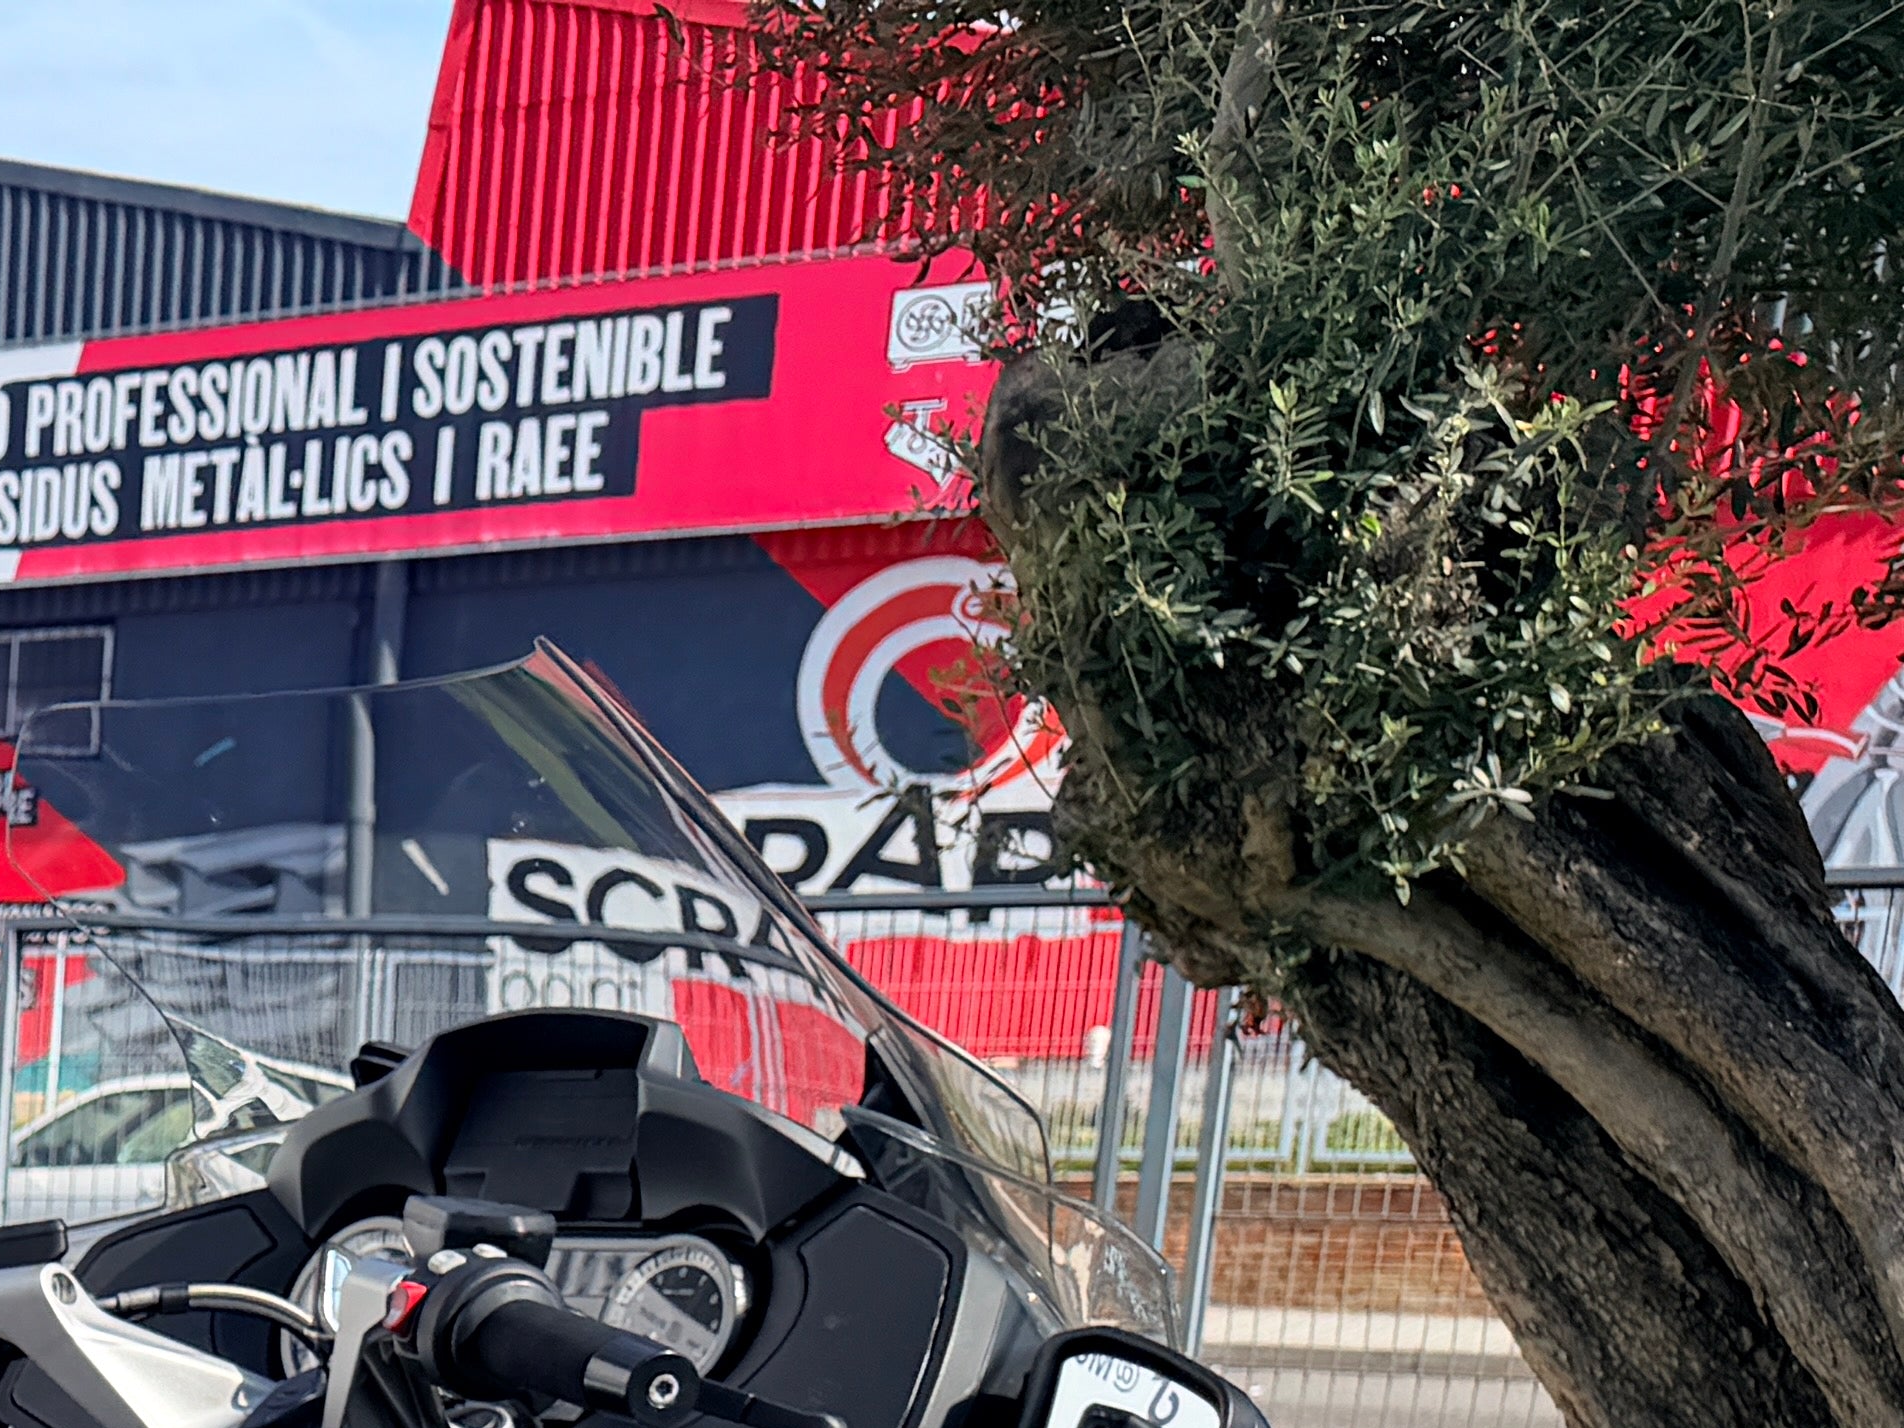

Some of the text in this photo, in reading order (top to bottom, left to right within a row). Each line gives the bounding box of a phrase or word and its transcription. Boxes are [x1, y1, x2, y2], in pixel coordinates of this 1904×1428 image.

[24, 346, 369, 458] PROFESSIONAL
[379, 341, 402, 423] I
[411, 305, 733, 420] SOSTENIBLE
[433, 424, 457, 506] I
[475, 408, 611, 502] RAEE
